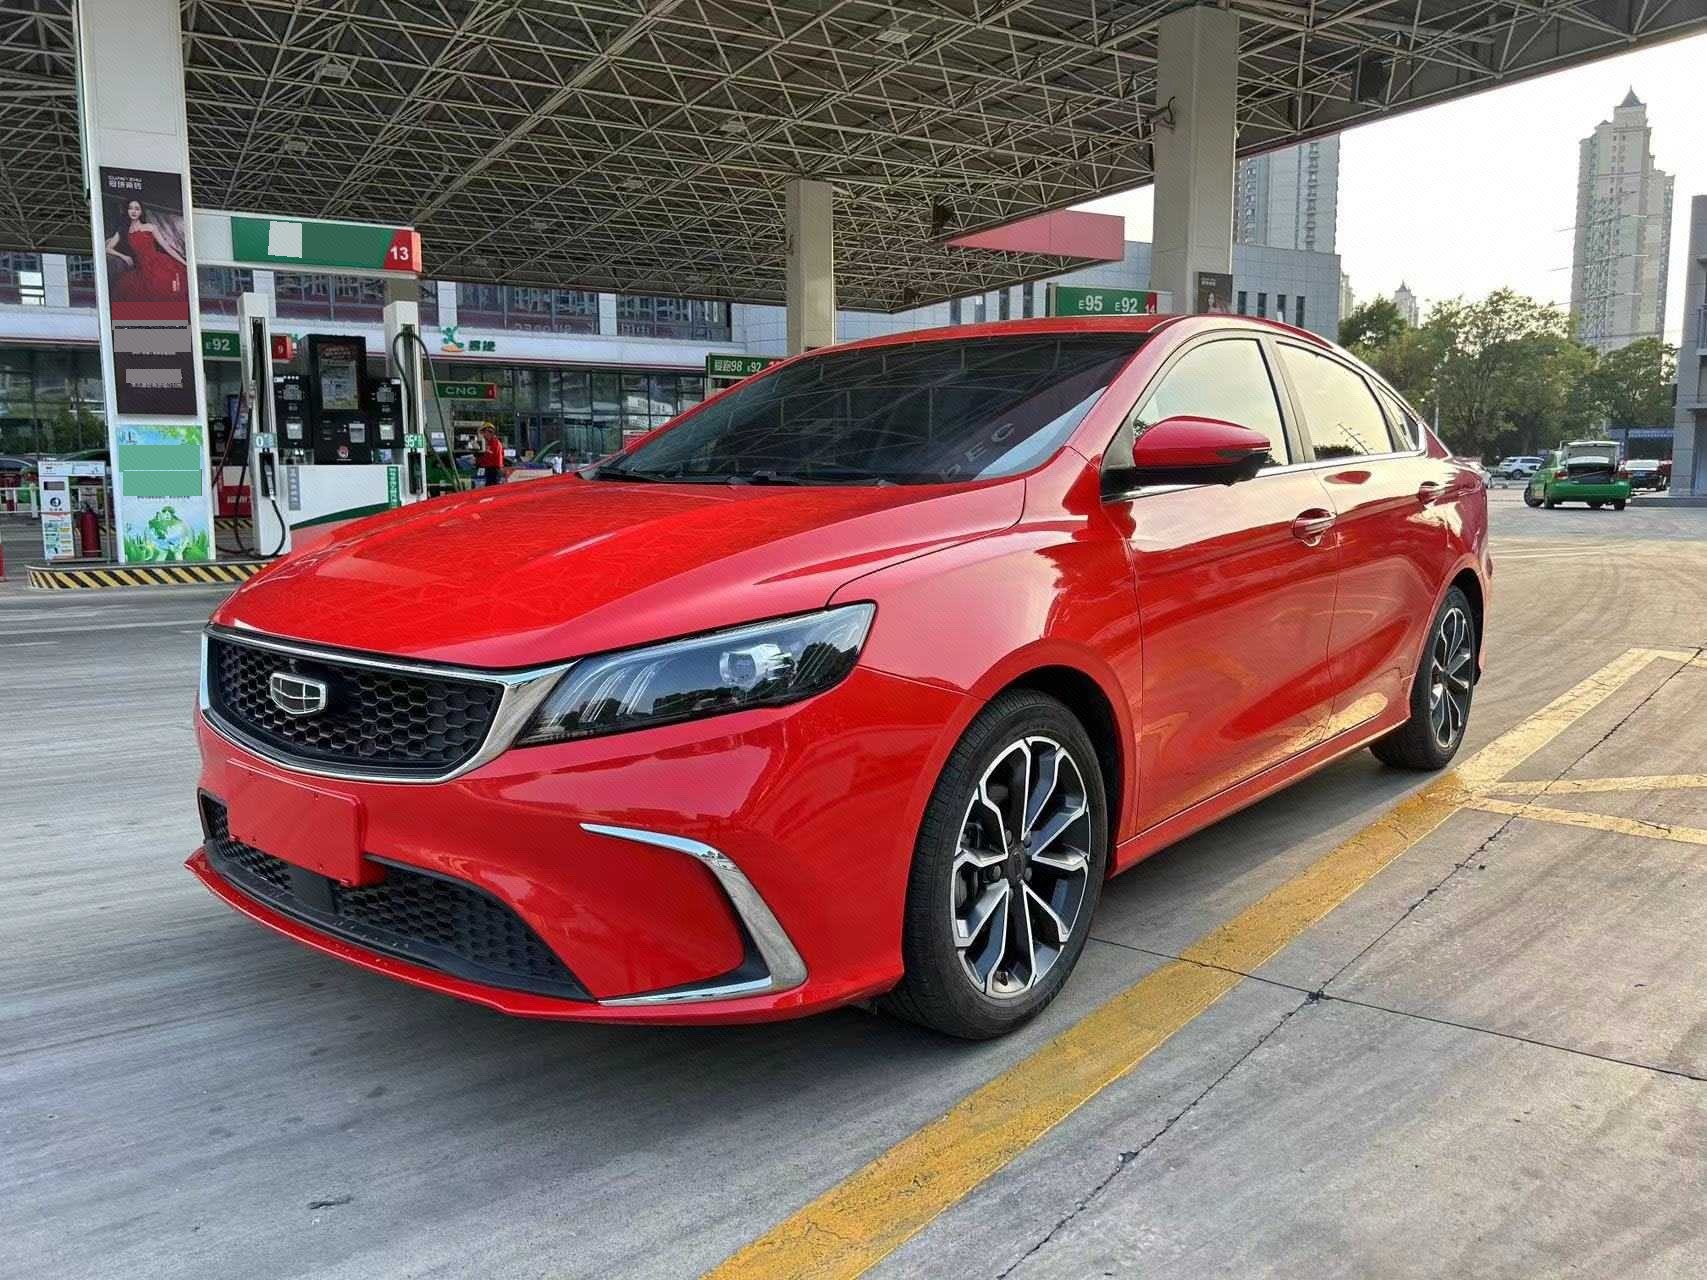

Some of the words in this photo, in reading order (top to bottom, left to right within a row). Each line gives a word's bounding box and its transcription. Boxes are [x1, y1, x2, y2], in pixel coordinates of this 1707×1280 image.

[390, 246, 409, 260] 13
[1079, 295, 1103, 312] E95
[1115, 297, 1138, 313] E92
[445, 386, 477, 395] CNG
